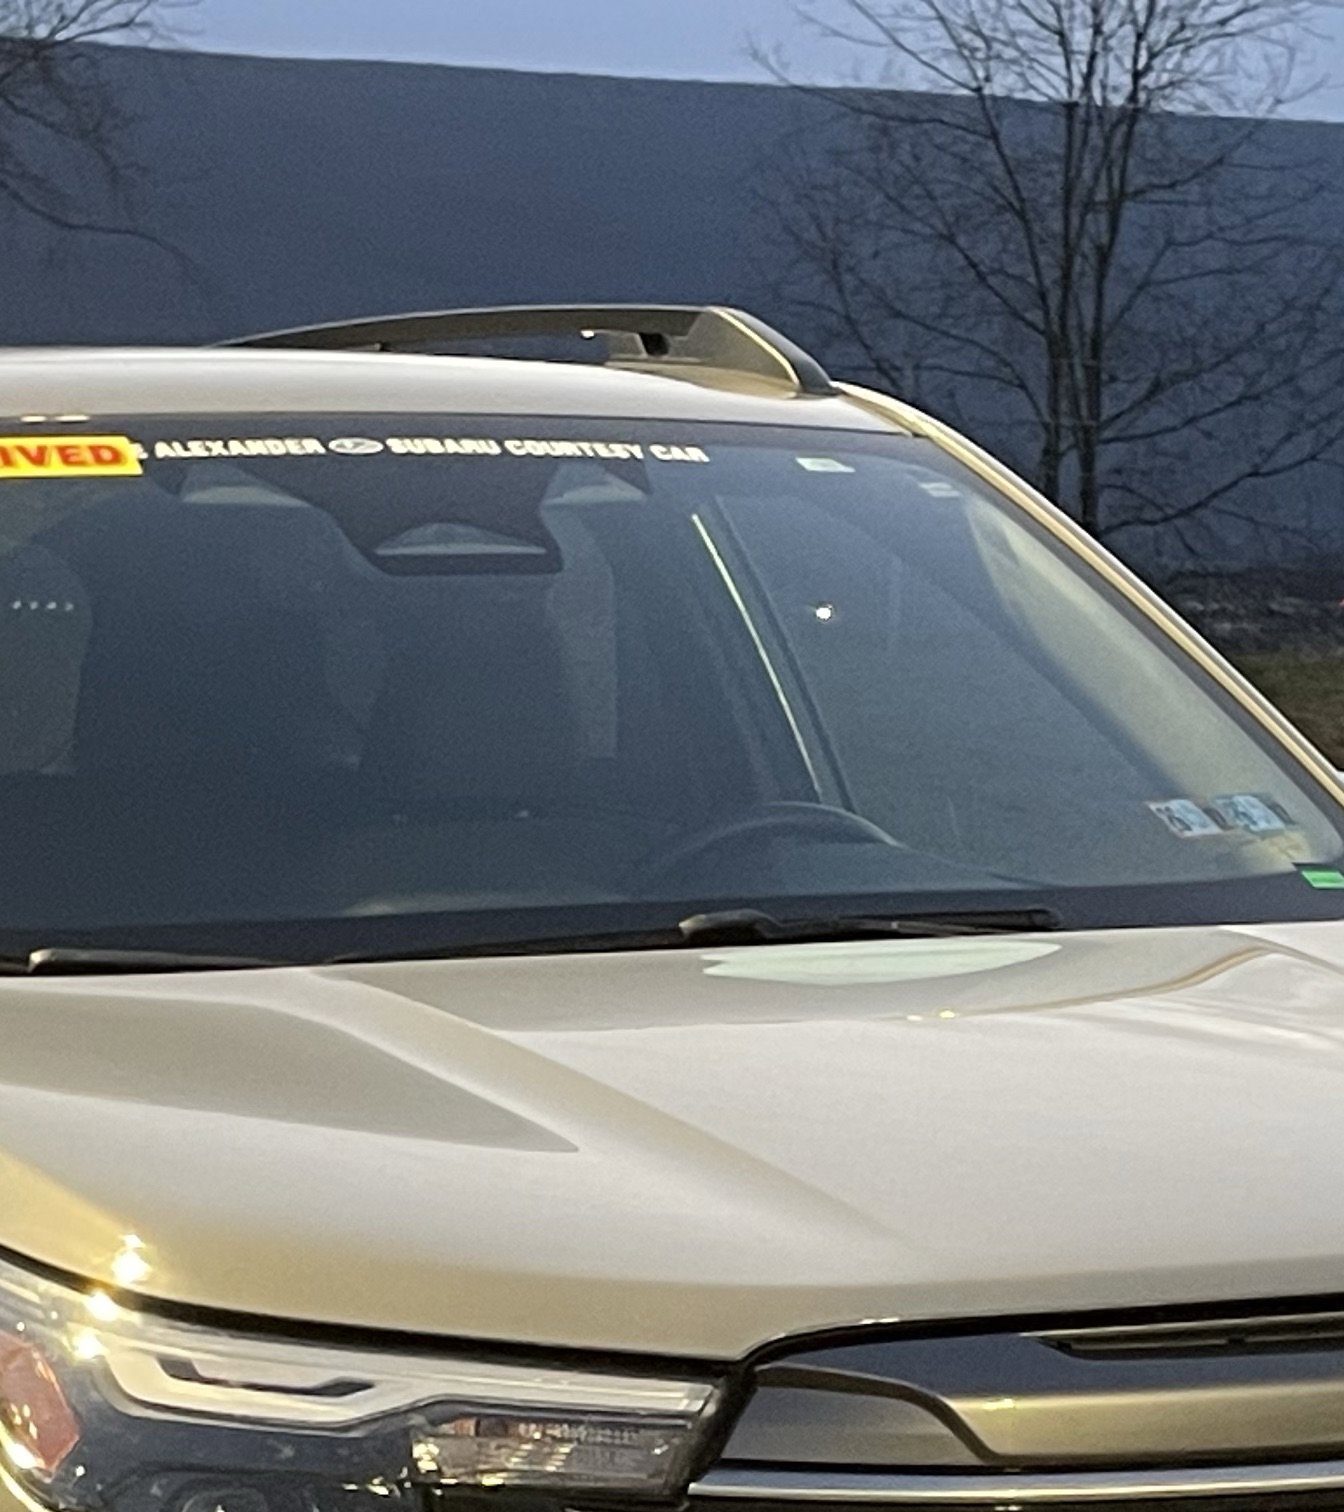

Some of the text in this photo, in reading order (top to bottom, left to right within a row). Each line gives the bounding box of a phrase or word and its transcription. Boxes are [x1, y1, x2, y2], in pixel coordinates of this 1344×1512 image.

[155, 437, 326, 459] ALEXANDER
[385, 437, 502, 455] SUBARU
[504, 439, 644, 460] COURTESY
[649, 443, 710, 462] CAR
